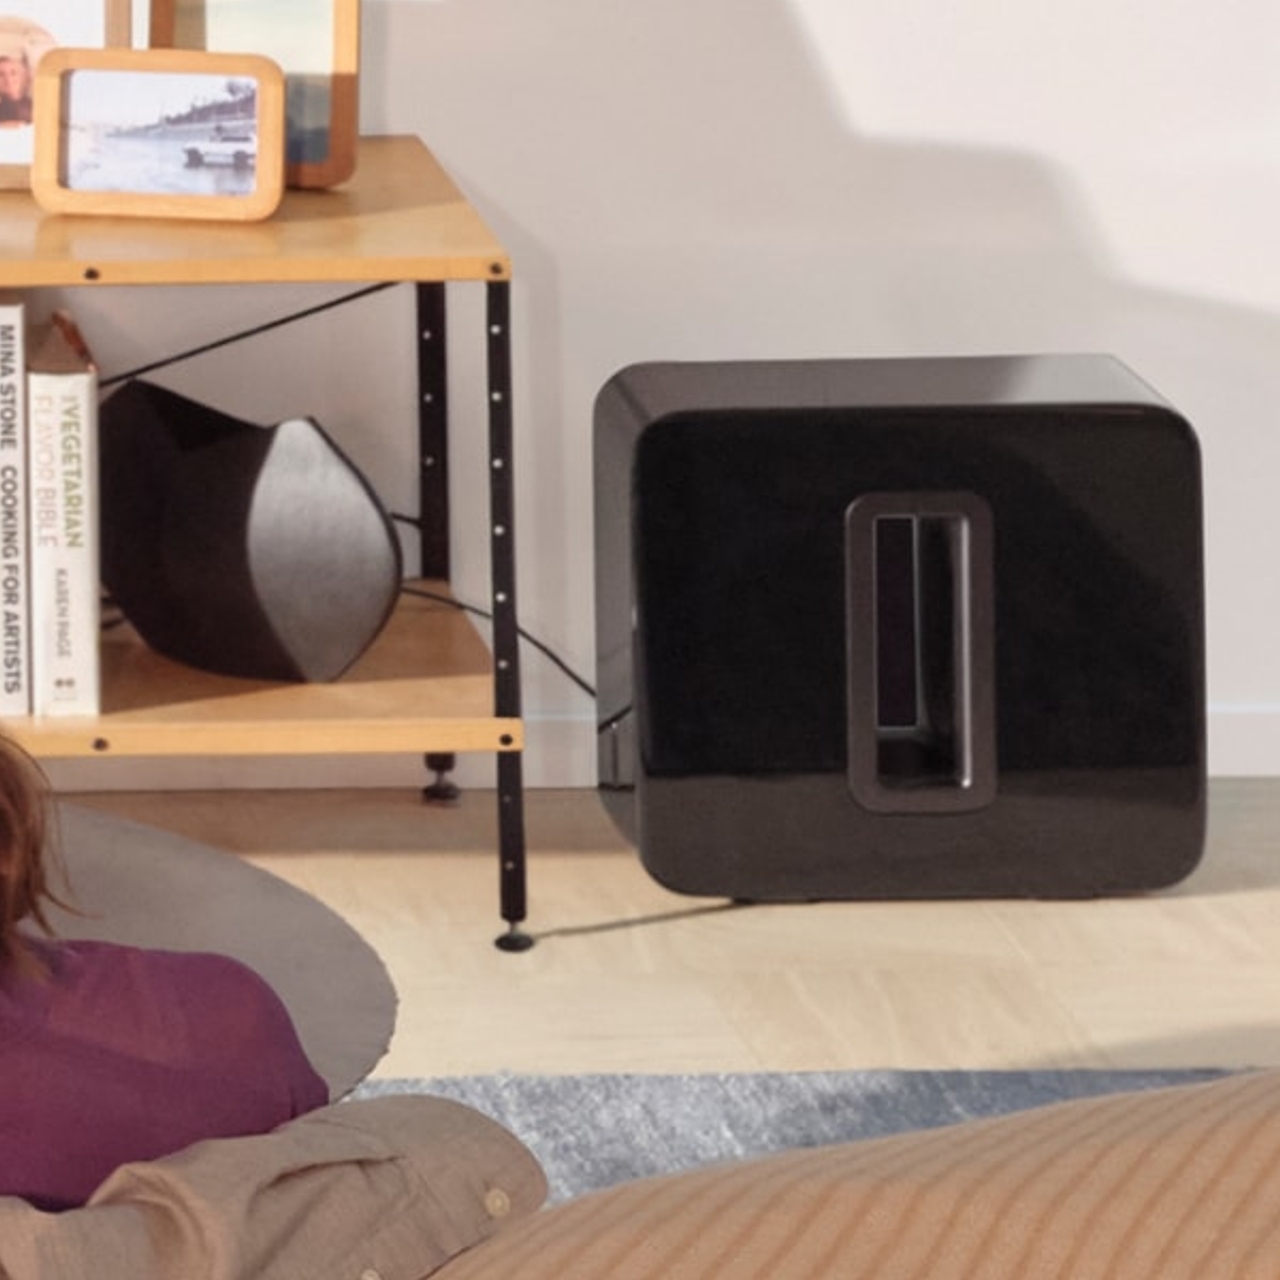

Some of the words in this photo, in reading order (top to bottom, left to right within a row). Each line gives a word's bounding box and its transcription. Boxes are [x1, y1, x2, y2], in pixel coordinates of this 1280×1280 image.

[0, 383, 17, 451] STONE
[35, 396, 55, 481] FLAVOR
[61, 403, 84, 549] VEGETARIAN
[0, 464, 20, 560] COOKING
[38, 486, 58, 548] BIBLE
[2, 562, 20, 606] FOR
[55, 567, 70, 619] KAREN
[3, 609, 22, 695] ARTISTS
[56, 621, 71, 659] PAGE
